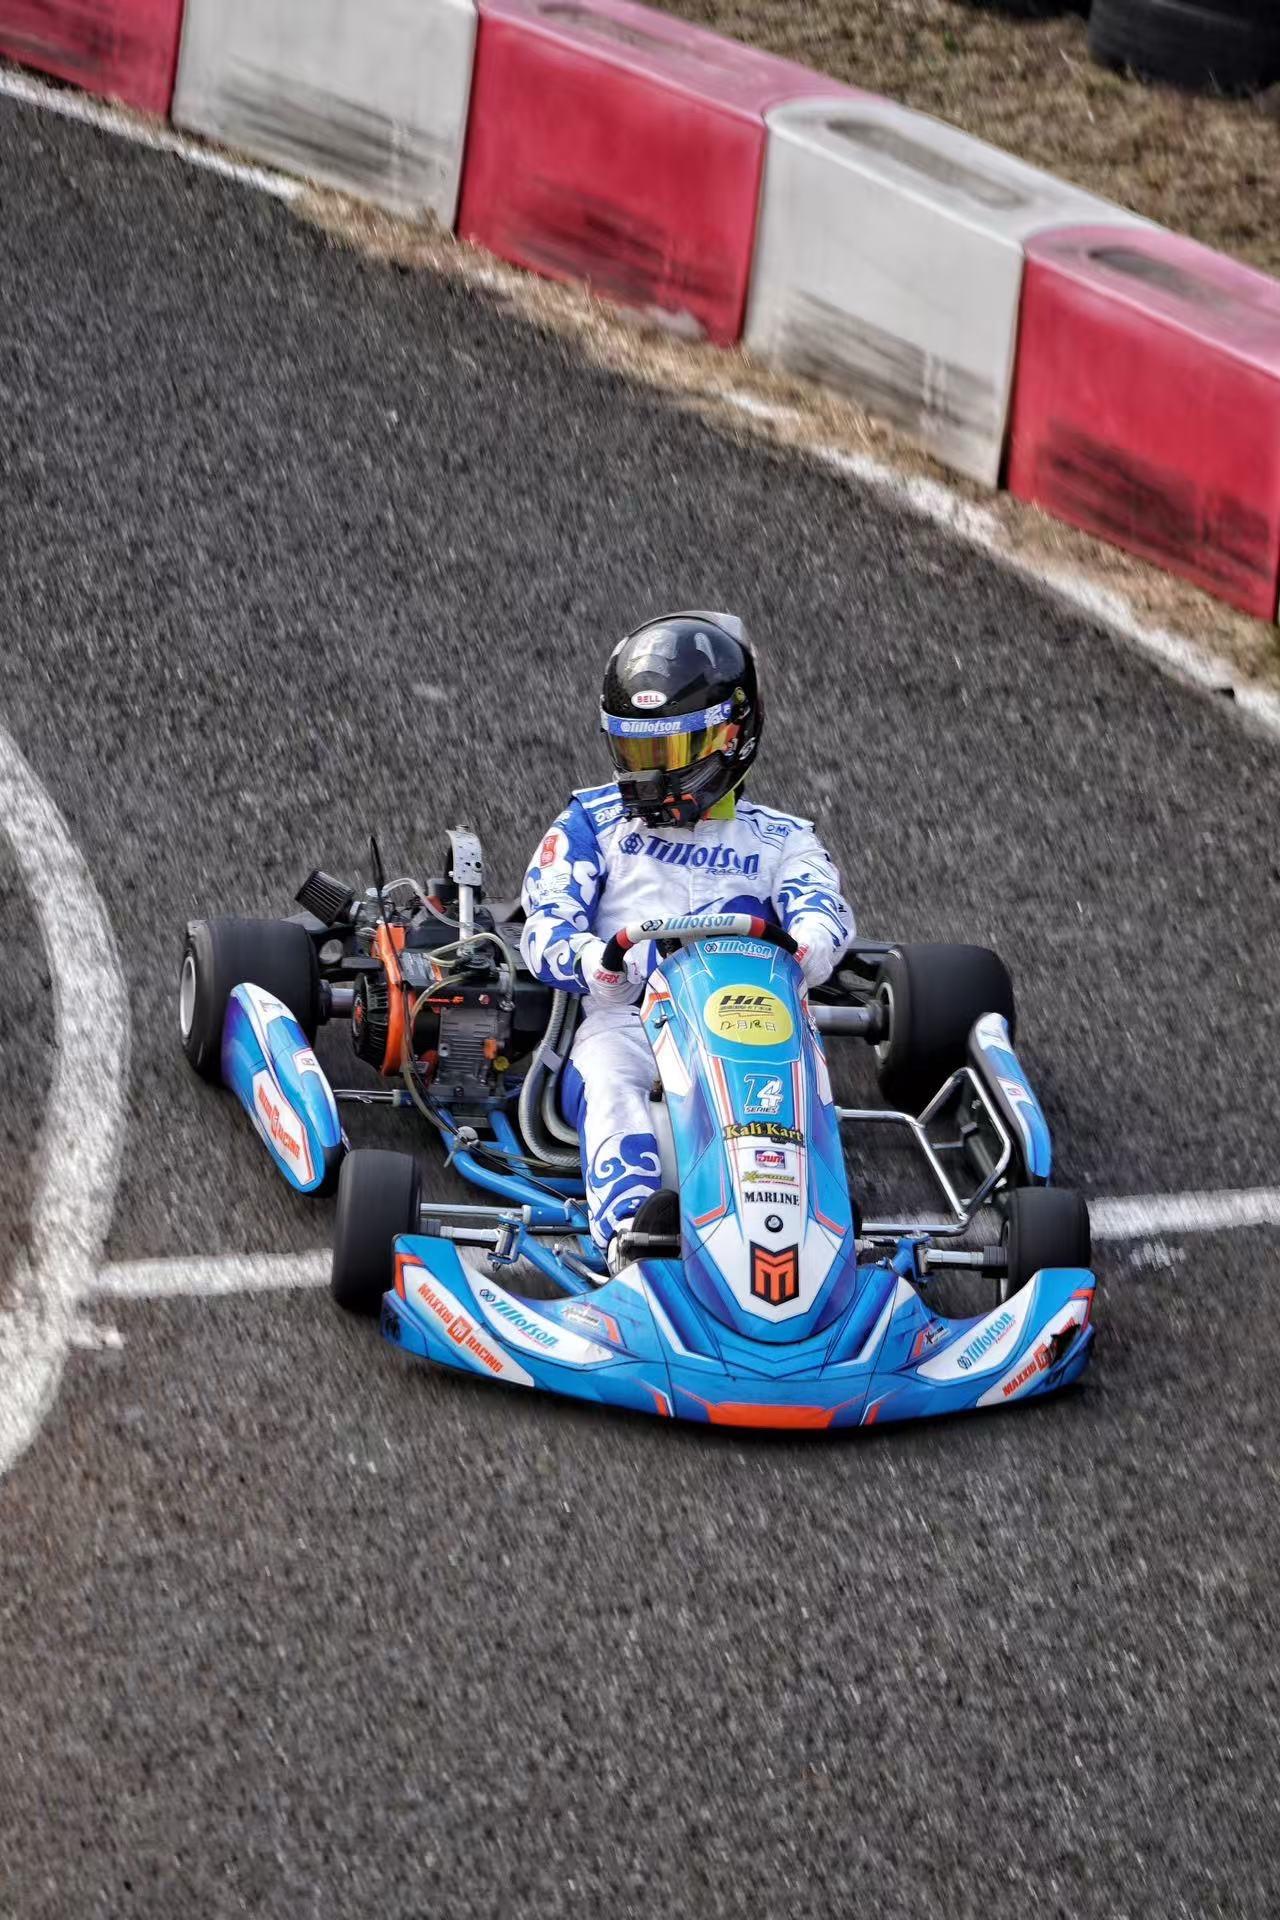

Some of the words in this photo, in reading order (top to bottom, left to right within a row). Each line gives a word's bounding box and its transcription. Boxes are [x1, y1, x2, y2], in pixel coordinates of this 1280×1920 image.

[637, 695, 661, 704] BELL
[630, 720, 681, 733] Tillotson
[663, 915, 736, 930] Tillotson
[718, 940, 771, 955] Tillotson
[745, 1106, 777, 1114] SERIES
[726, 1122, 762, 1138] Kali
[766, 1122, 803, 1142] Kart
[745, 1191, 800, 1206] MARLINE
[491, 1299, 559, 1347] Tillotson
[964, 1312, 1012, 1362] Tillotson
[465, 1336, 504, 1373] RACING
